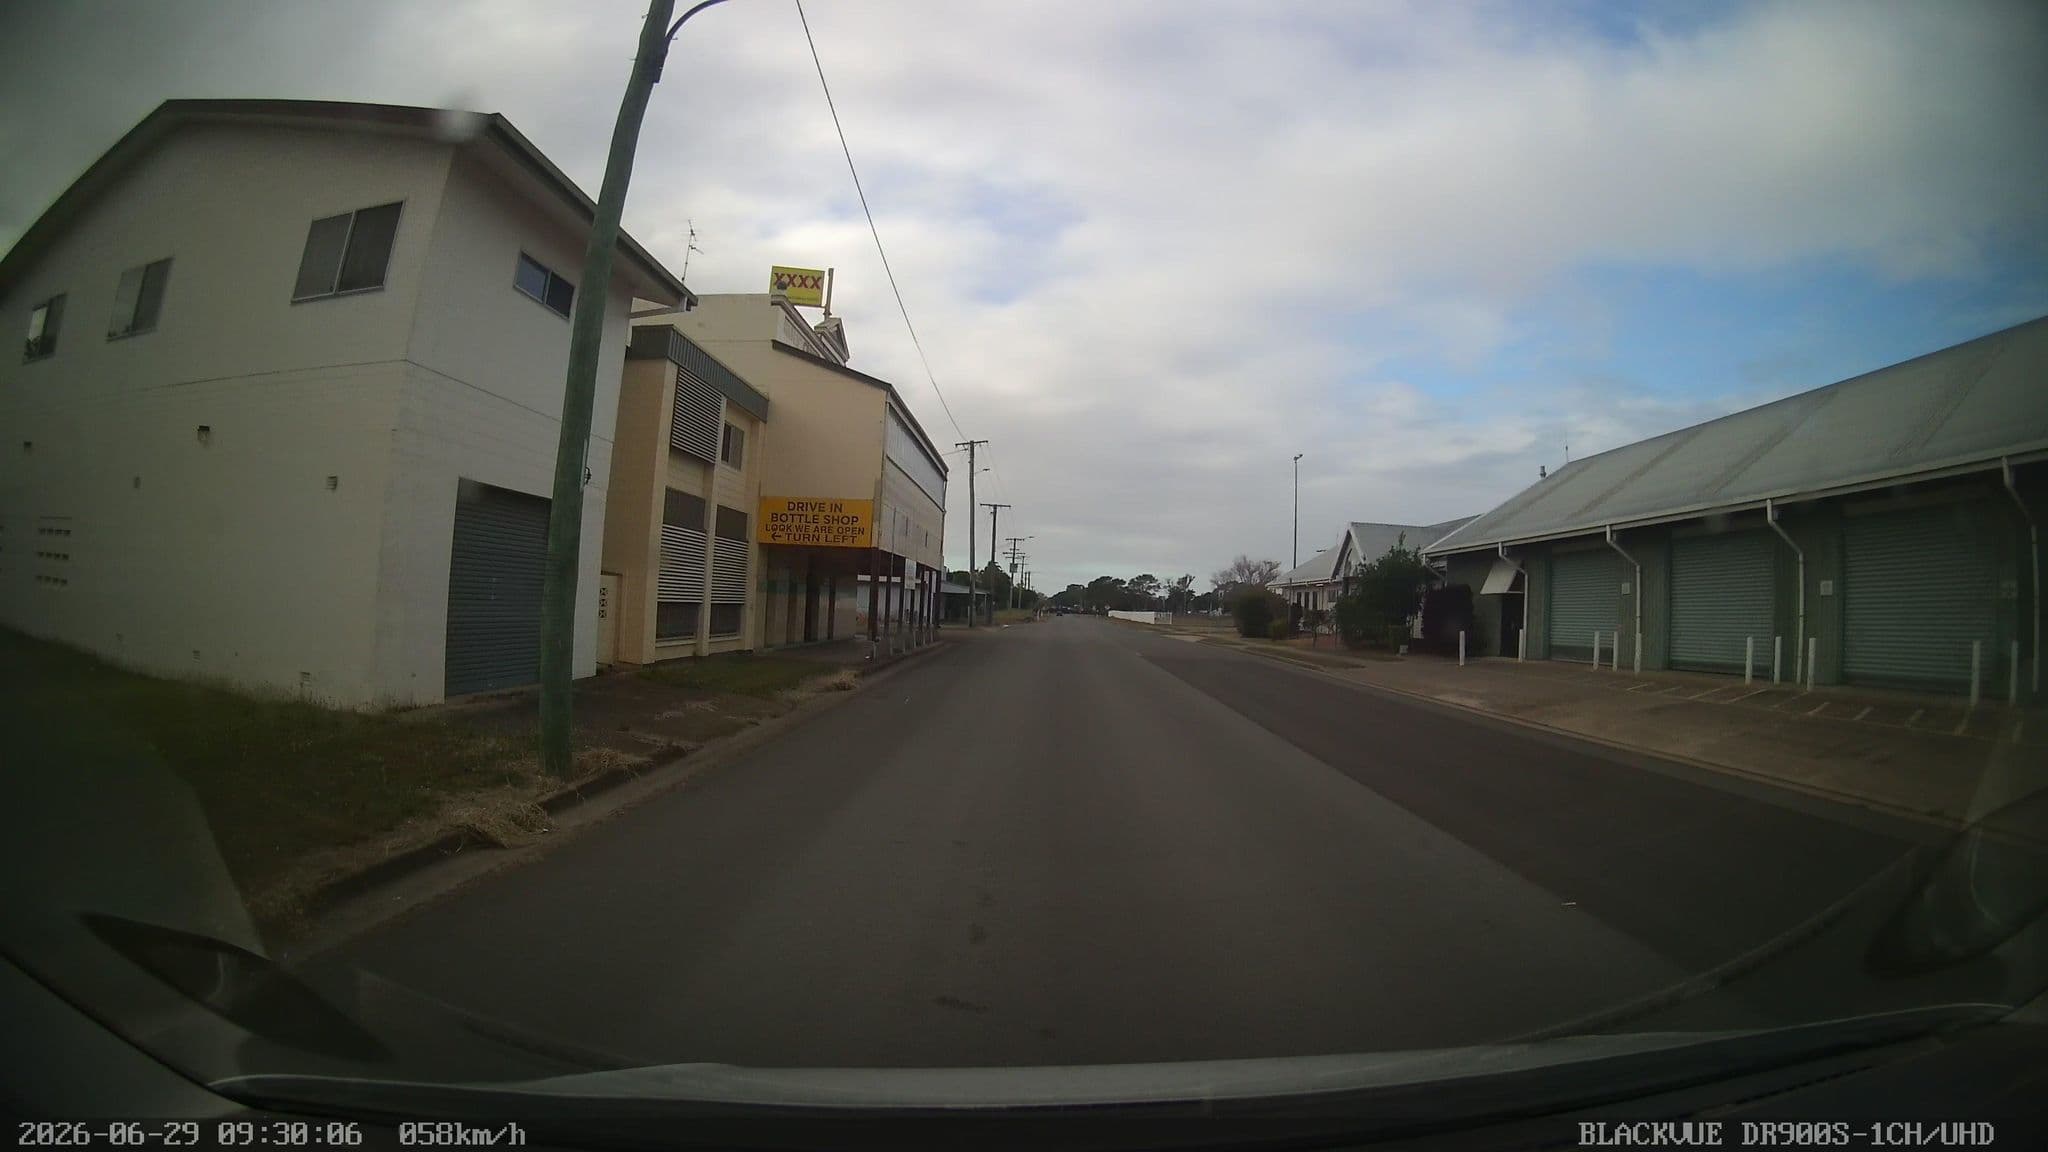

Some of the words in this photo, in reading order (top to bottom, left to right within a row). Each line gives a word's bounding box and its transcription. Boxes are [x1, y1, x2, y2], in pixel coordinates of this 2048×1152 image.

[774, 272, 822, 289] XXXX
[787, 501, 826, 512] DRIVE
[830, 503, 843, 513] IN
[771, 512, 819, 524] BOTTLE
[823, 515, 859, 526] SHOP
[765, 523, 793, 532] LOOK
[795, 524, 810, 533] WE
[813, 525, 832, 534] ARE
[836, 526, 865, 535] OPEN
[785, 532, 820, 542] TURN
[825, 534, 857, 544] LEFT
